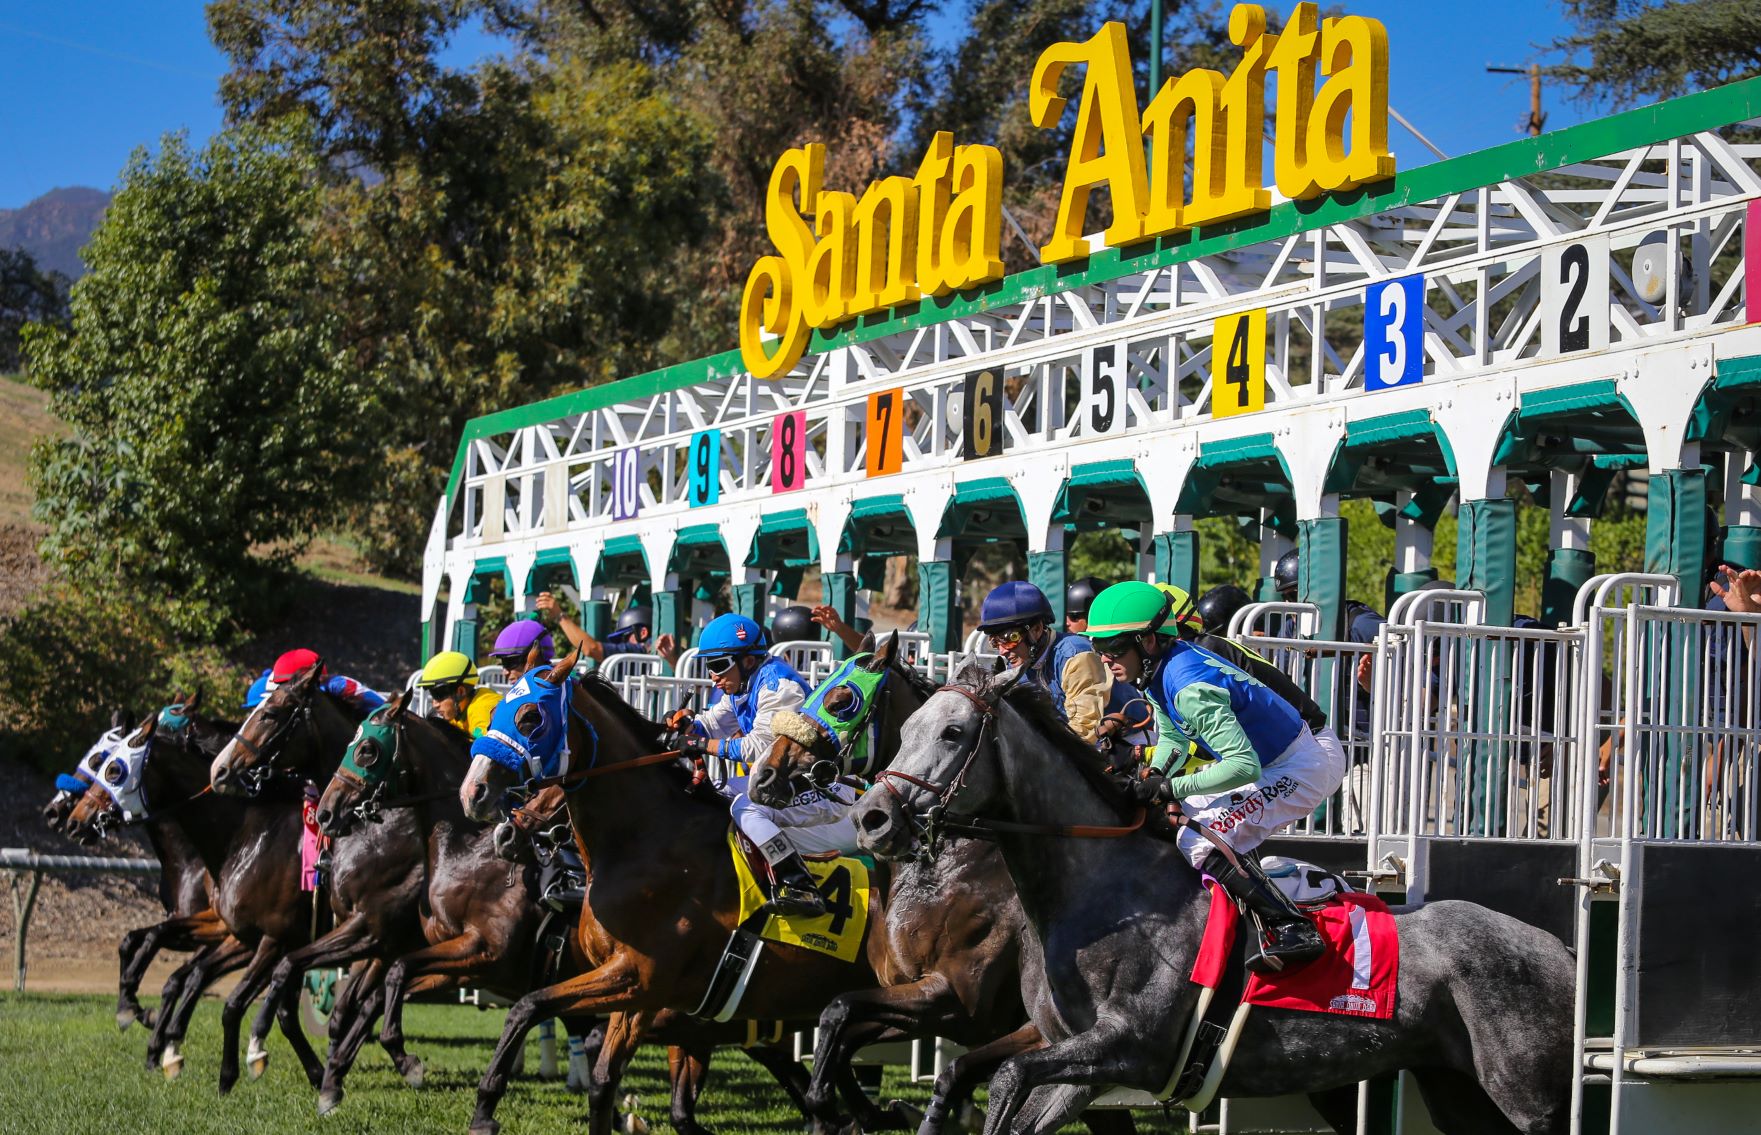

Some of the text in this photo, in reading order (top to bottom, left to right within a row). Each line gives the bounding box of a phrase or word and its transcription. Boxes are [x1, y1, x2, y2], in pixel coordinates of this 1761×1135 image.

[740, 3, 1394, 379] Santa Anita
[1379, 282, 1406, 385] 3
[1559, 244, 1590, 353] 2
[1092, 345, 1115, 433] 5
[1226, 315, 1250, 407] 4
[781, 413, 796, 488] 8
[876, 393, 893, 470] 7
[973, 371, 994, 456] 6
[614, 449, 637, 518] 10
[696, 434, 710, 504] 9
[765, 838, 788, 860] RB
[1217, 806, 1235, 821] the
[818, 865, 854, 936] 4
